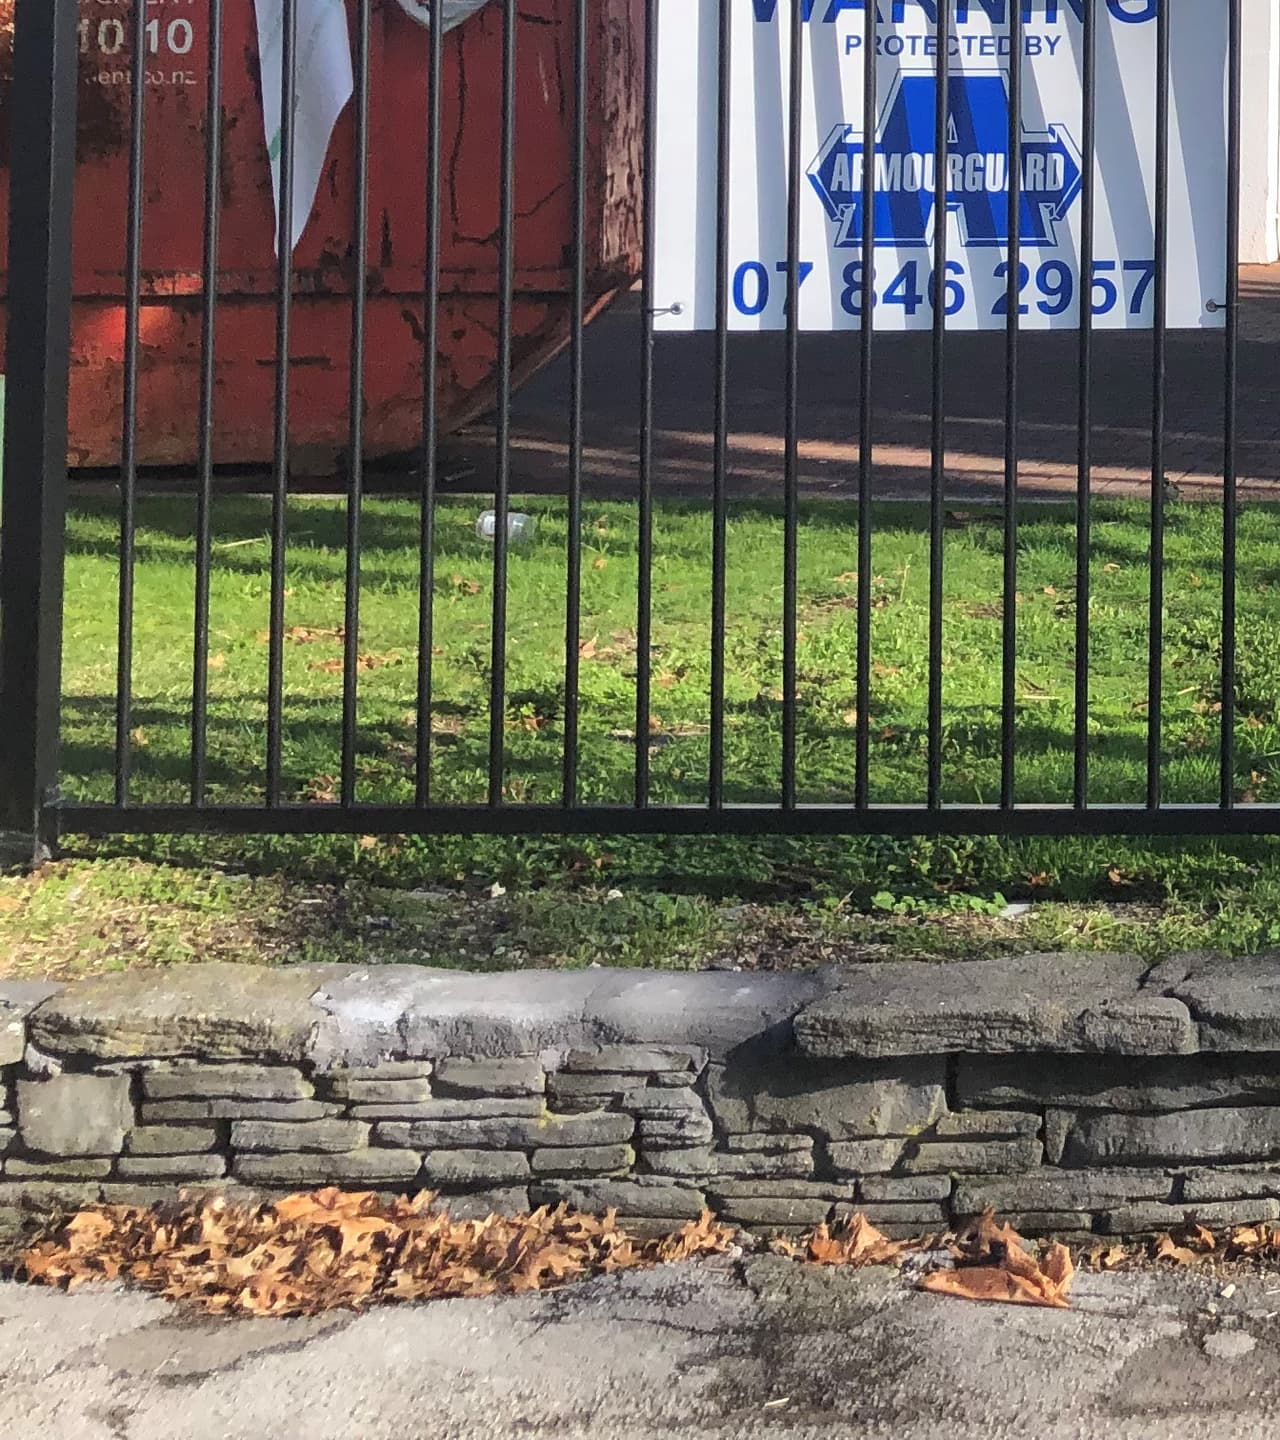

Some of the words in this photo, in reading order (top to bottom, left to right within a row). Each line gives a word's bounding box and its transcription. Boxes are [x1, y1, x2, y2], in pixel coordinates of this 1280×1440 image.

[1024, 35, 1062, 55] BY
[732, 260, 814, 316] 07
[840, 260, 966, 316] 846
[991, 260, 1157, 316] 2957
